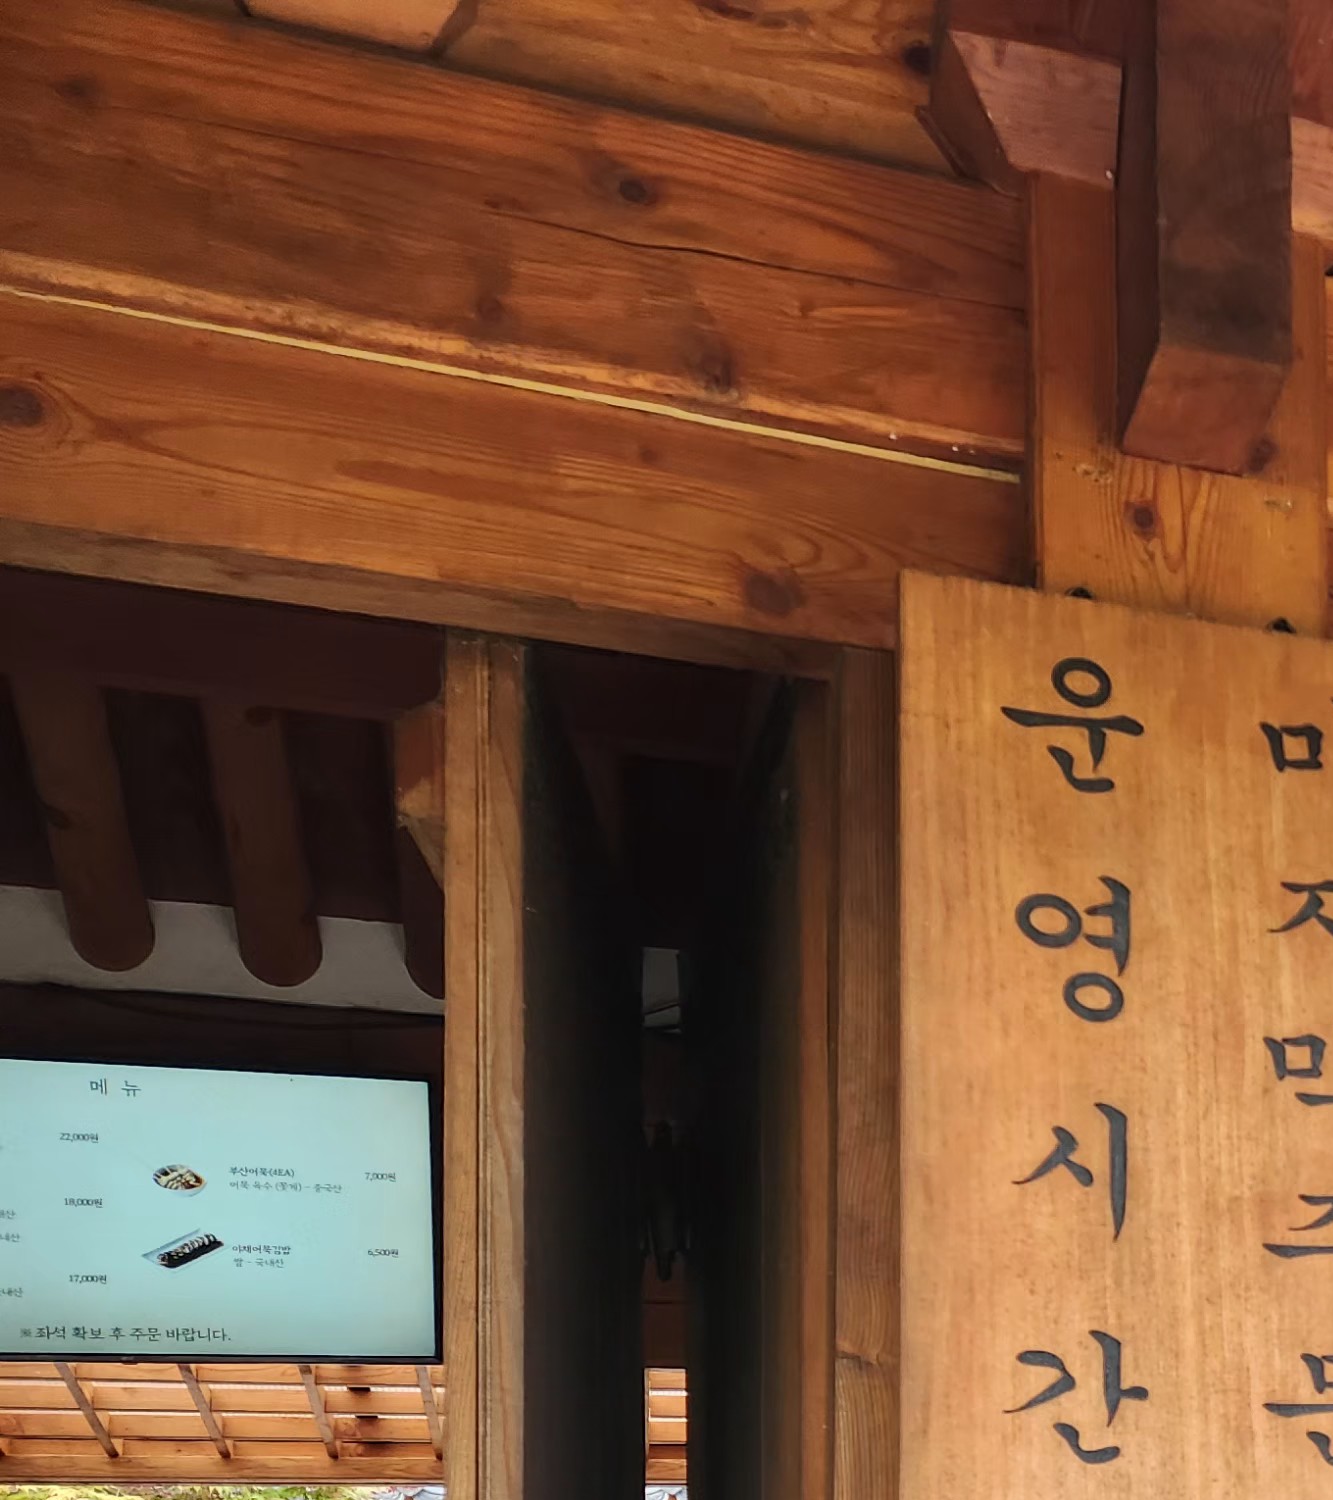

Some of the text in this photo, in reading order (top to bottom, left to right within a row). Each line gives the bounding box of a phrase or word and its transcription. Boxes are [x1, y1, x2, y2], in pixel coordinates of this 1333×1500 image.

[1000, 656, 1149, 1464] 운영시간
[35, 1325, 232, 1342] 좌석 확보 후 주문 바랍니다.
